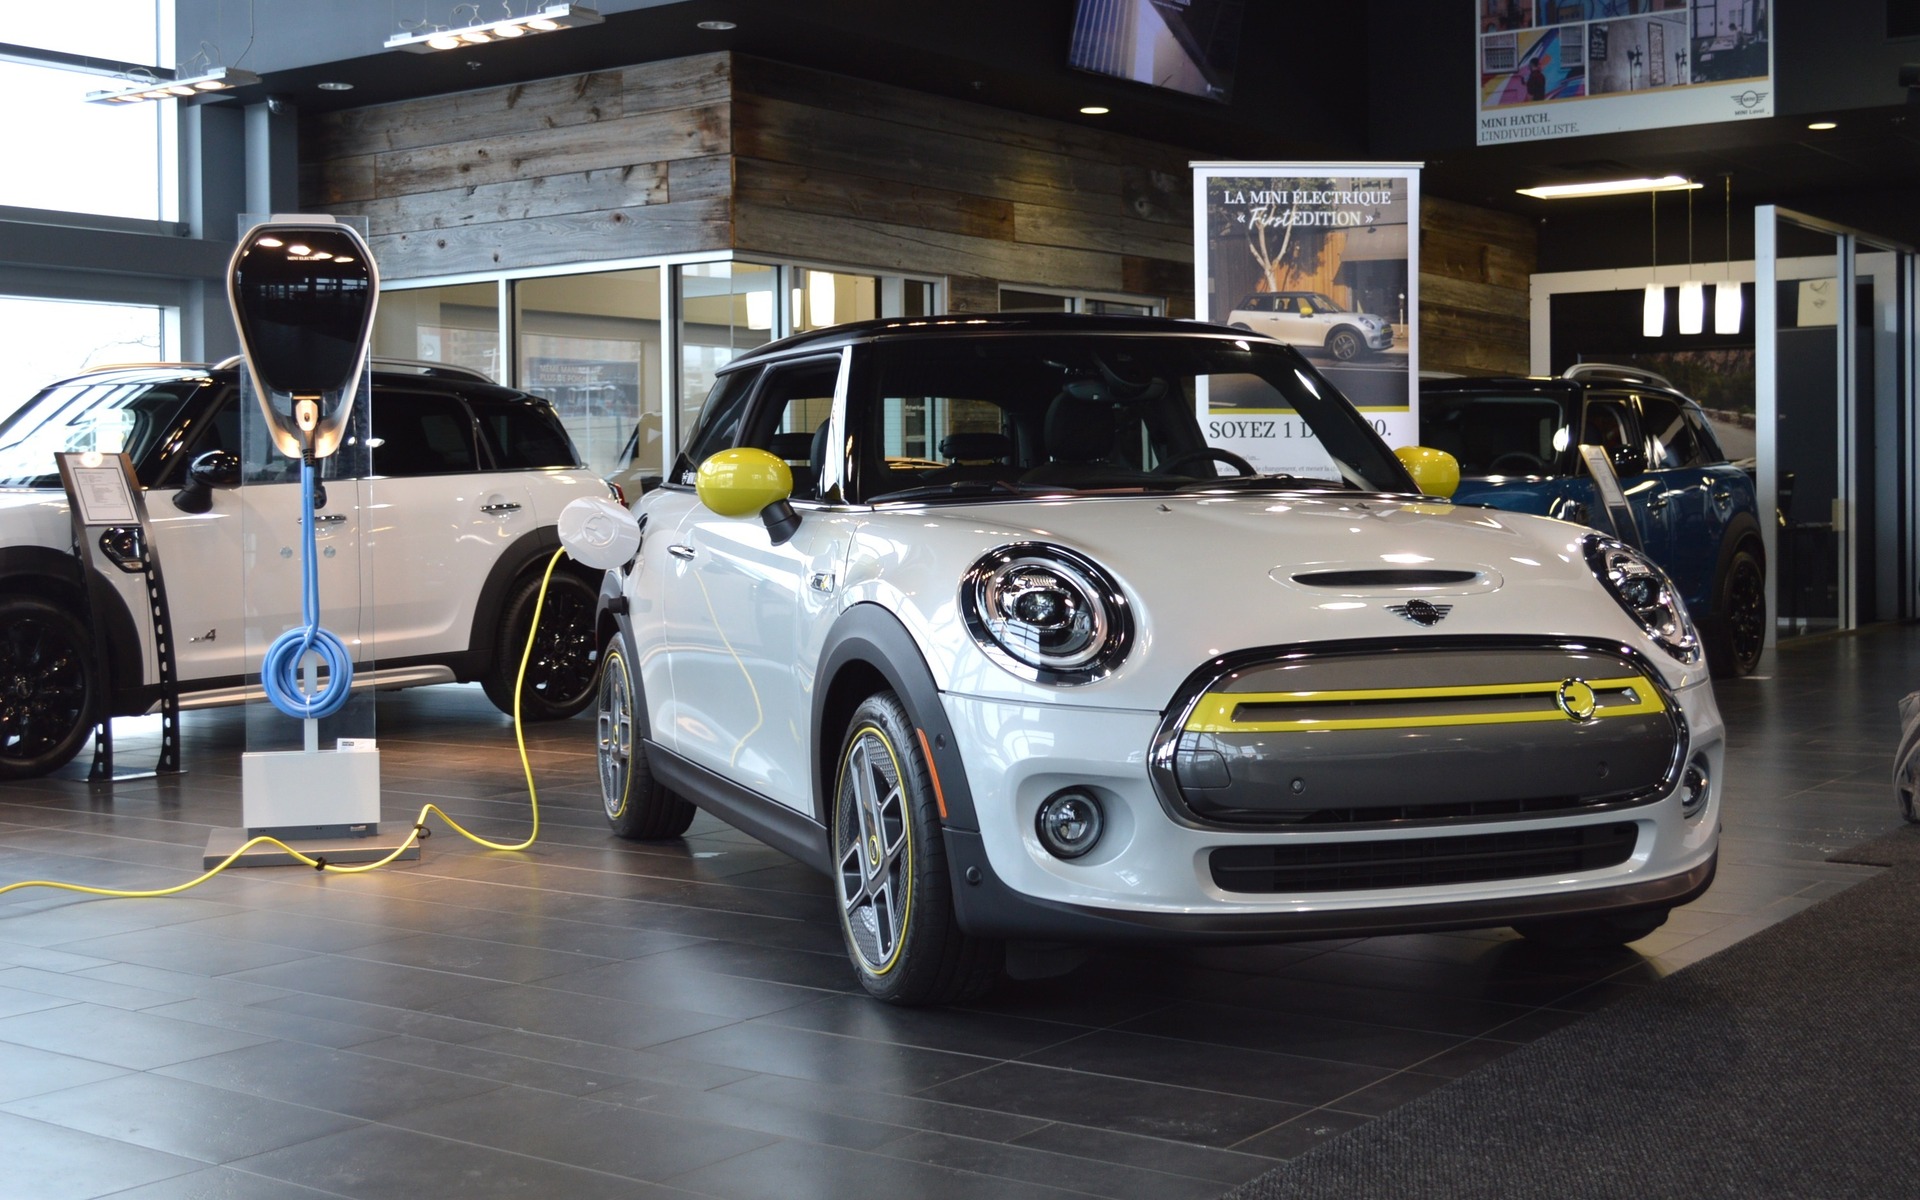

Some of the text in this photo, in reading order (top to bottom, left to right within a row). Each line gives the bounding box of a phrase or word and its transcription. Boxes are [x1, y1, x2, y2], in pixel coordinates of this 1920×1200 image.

[1481, 112, 1550, 129] MINI HATCH.
[1224, 188, 1391, 206] LA MINI ÉLECTRIQUE
[1209, 421, 1276, 438] SOYEZ
[1284, 421, 1293, 438] 1
